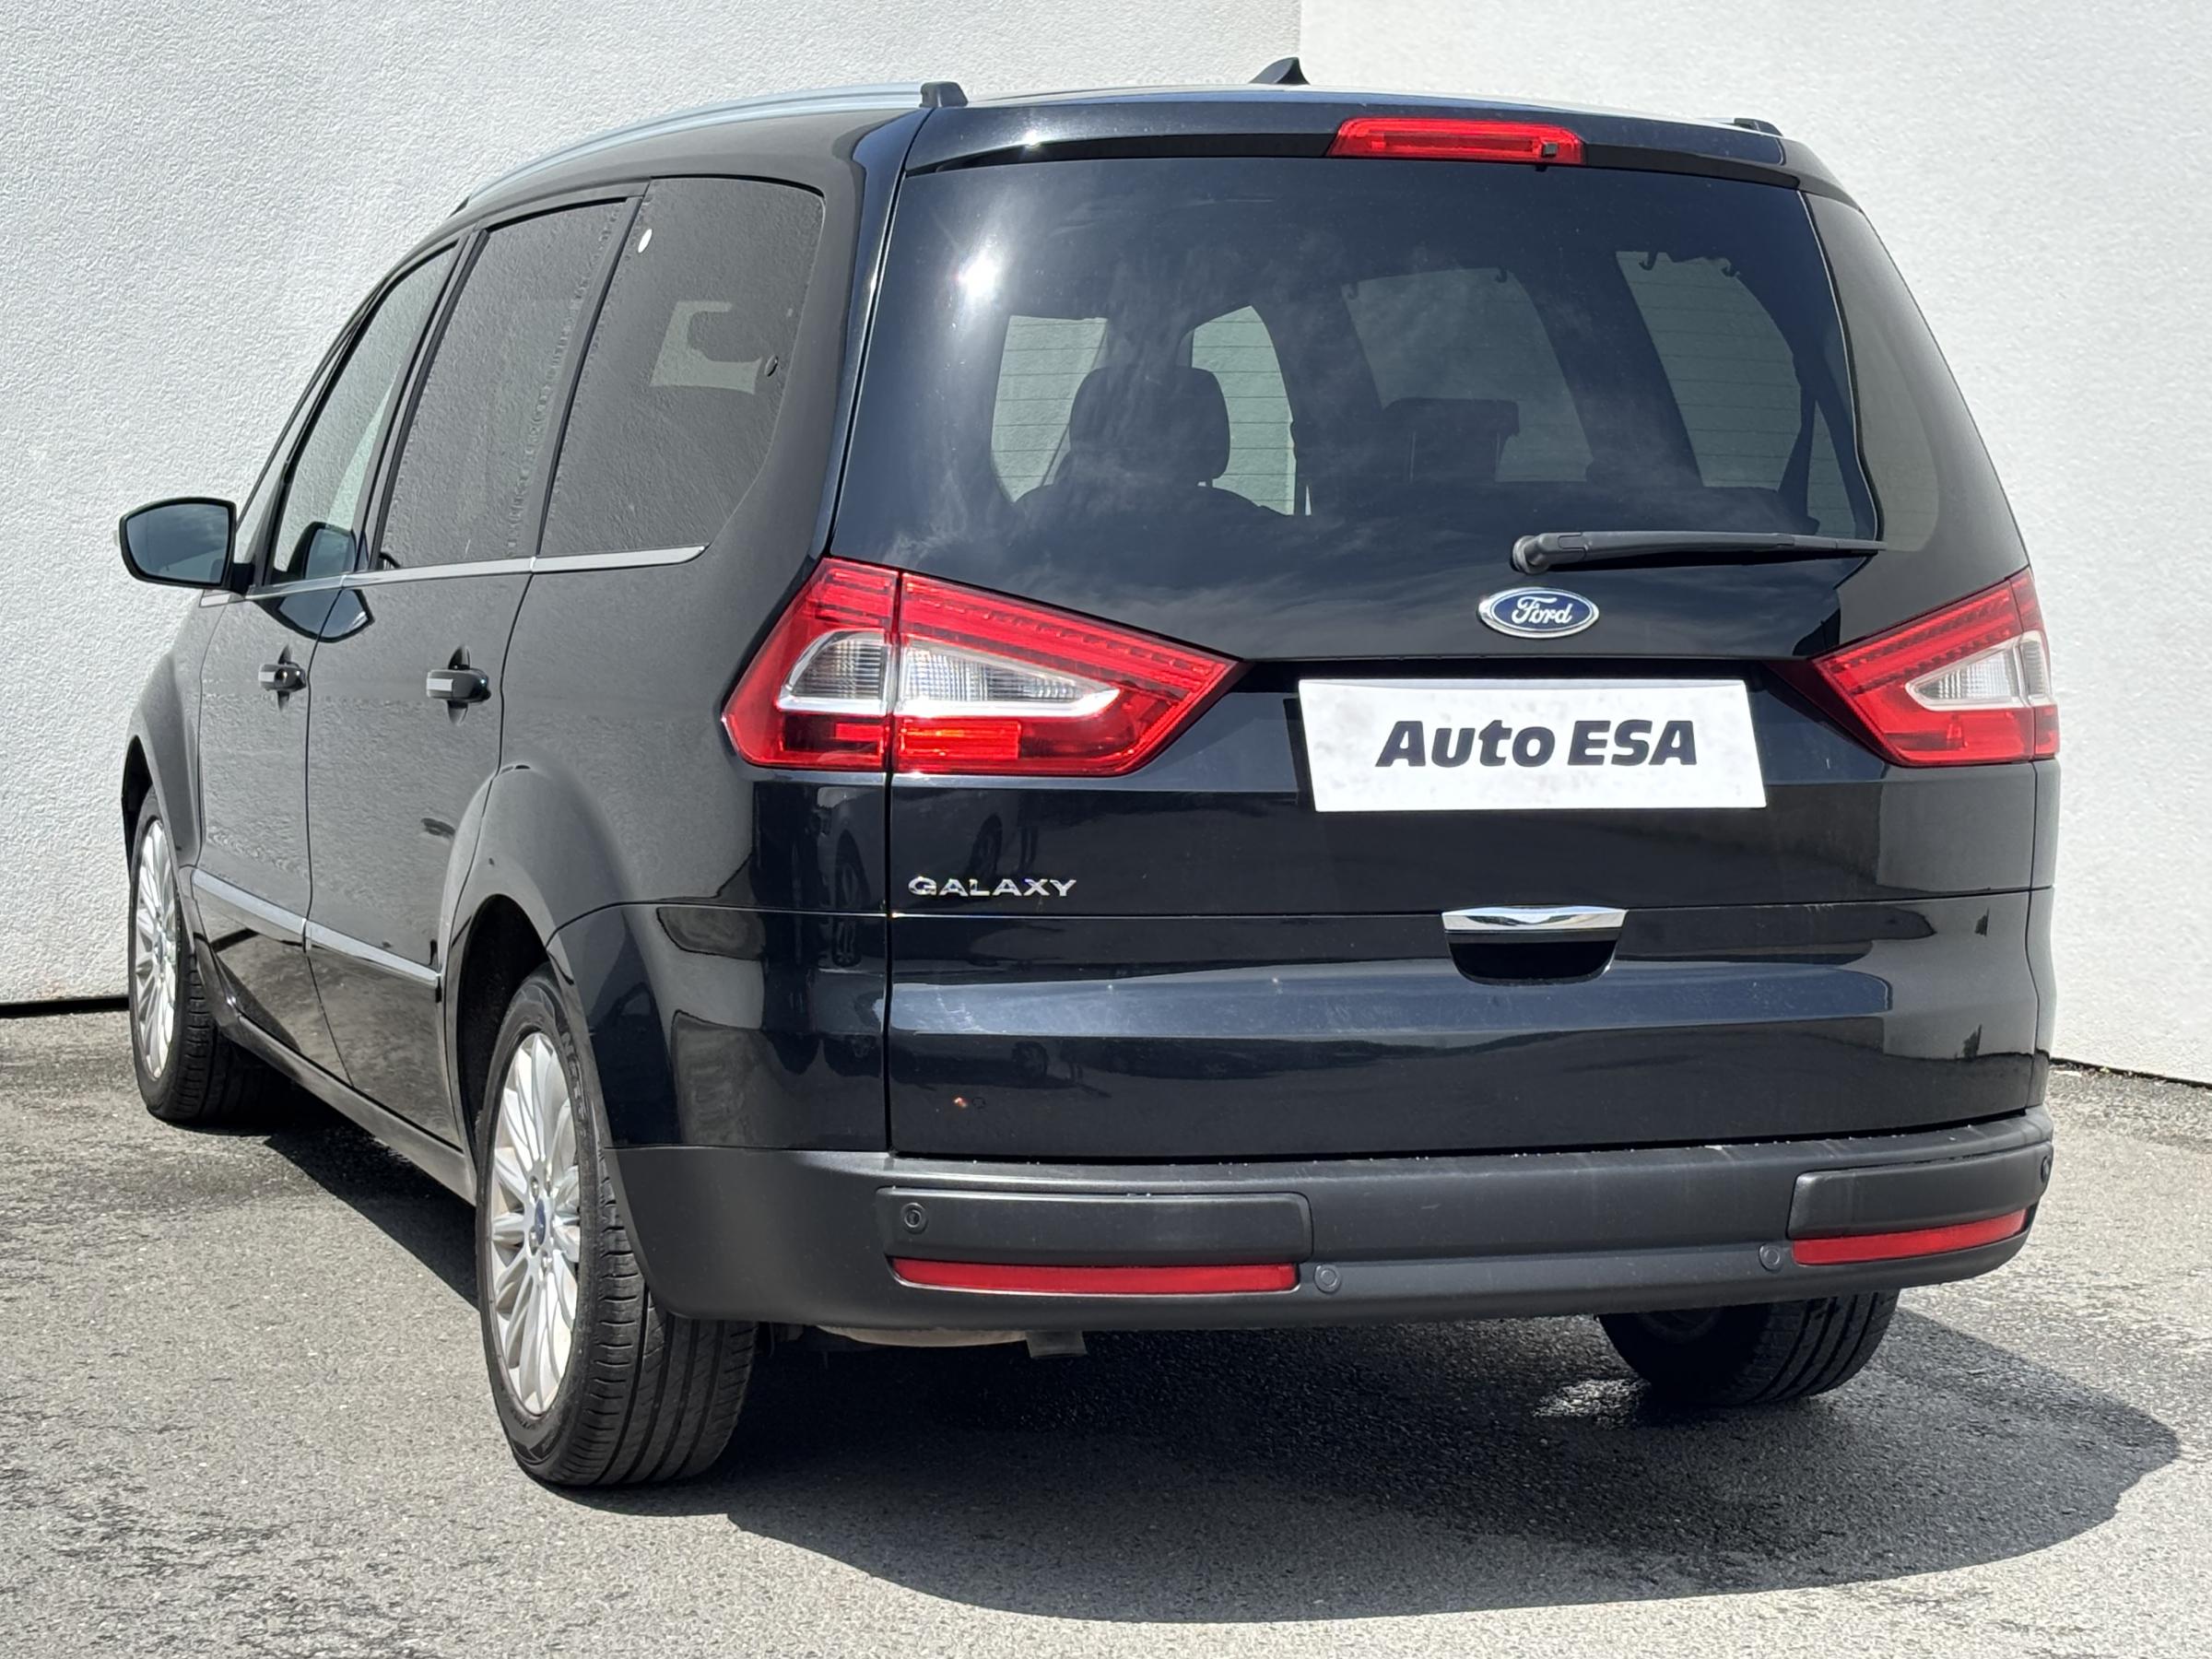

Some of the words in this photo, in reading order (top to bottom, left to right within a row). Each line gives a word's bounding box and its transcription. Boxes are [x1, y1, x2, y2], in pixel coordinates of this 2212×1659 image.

[1512, 595, 1574, 624] Ford
[1375, 719, 1556, 768] Auto
[1567, 719, 1697, 767] ESA
[908, 876, 1077, 897] GALAXY
